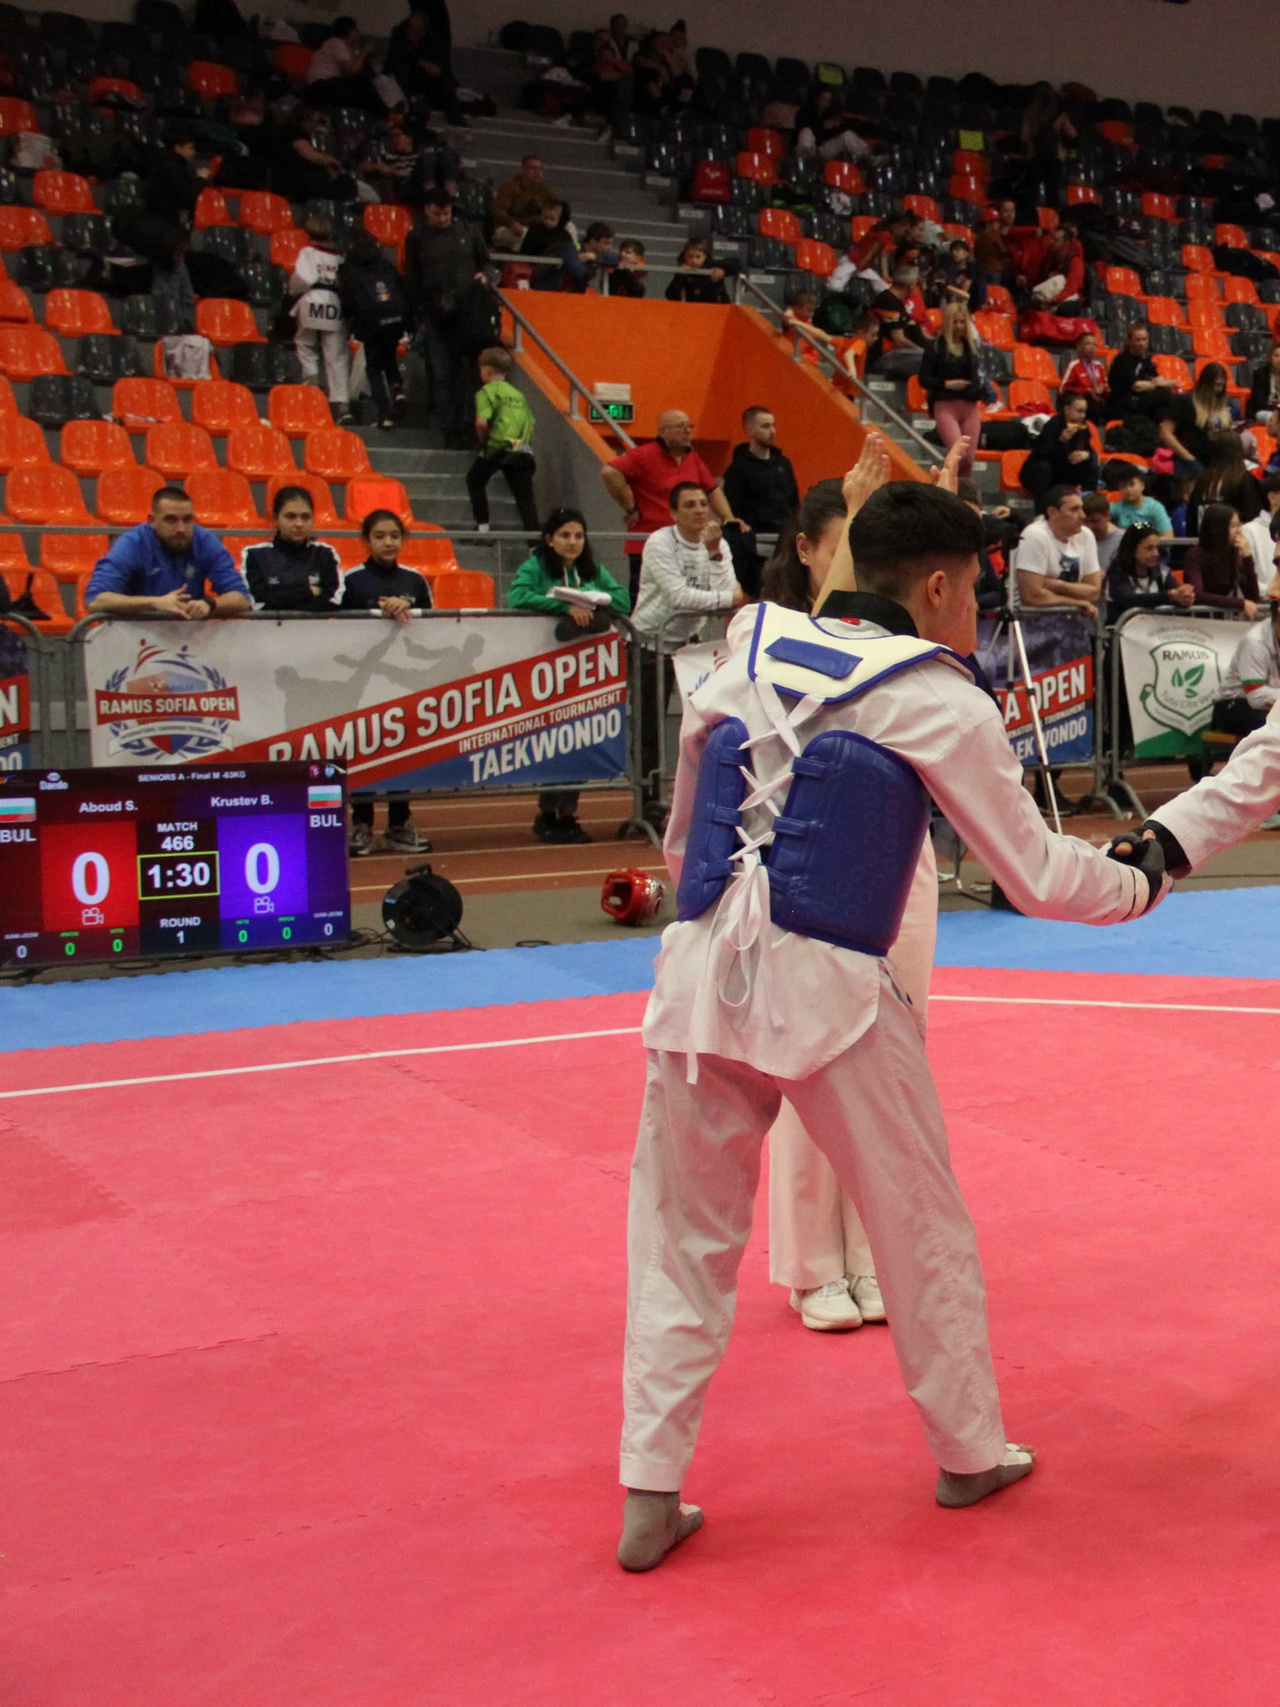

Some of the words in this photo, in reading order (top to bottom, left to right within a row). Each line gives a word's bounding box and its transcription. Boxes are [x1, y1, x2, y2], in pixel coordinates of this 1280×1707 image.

[1163, 650, 1209, 661] RAMUS
[417, 671, 522, 737] SOFIA
[531, 640, 619, 700] OPEN
[100, 699, 152, 715] RAMUS
[156, 698, 198, 713] SOFIA
[200, 697, 235, 711] OPEN
[459, 716, 546, 753] INTERNATIONAL
[549, 690, 621, 723] TOURNAMENT
[469, 709, 621, 783] TAEKWONDO
[138, 773, 176, 782] SENIORS
[178, 773, 185, 781] A
[191, 772, 211, 780] Final
[79, 801, 122, 813] Aboud
[125, 801, 138, 811] S.
[210, 796, 258, 808] Krustev
[261, 795, 273, 805] B.
[157, 822, 198, 832] MATCH
[310, 814, 342, 828] BUL
[0, 829, 37, 843] BUL
[161, 836, 194, 851] 466
[147, 862, 210, 888] 1:30
[245, 843, 280, 894] 0
[71, 851, 110, 905] 0
[160, 916, 201, 928] ROUND
[282, 927, 292, 939] 0
[324, 923, 333, 936] 0
[177, 931, 185, 944] 1
[238, 930, 248, 943] 0
[16, 945, 27, 958] 0
[64, 942, 76, 956] 0
[112, 939, 123, 952] 0
